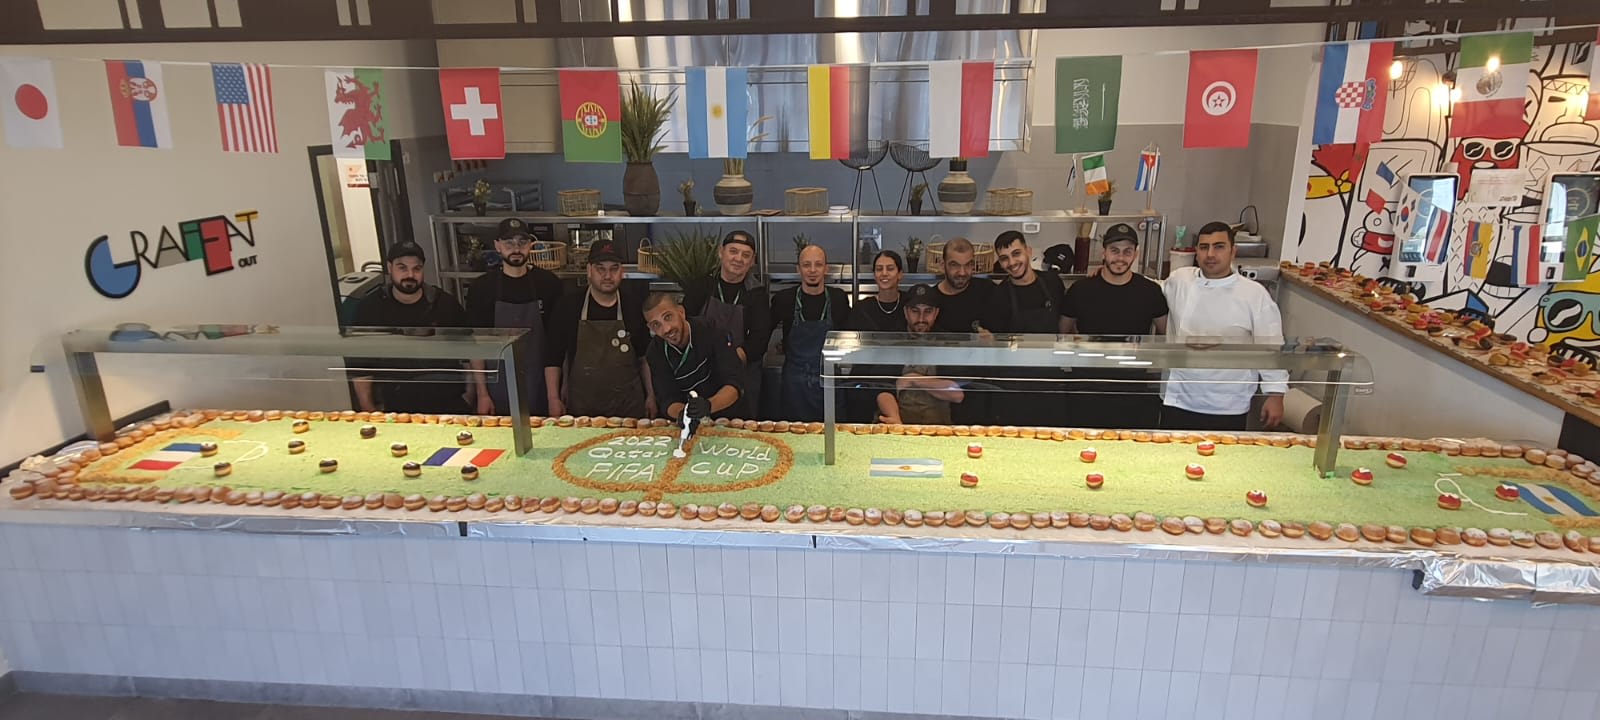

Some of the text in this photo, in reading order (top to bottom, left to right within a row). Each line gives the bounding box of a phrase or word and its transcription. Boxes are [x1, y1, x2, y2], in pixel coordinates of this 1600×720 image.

[238, 254, 258, 268] OUT
[607, 436, 672, 447] 2022
[588, 447, 668, 459] Qatar
[699, 442, 771, 461] World
[585, 462, 655, 481] FIFA
